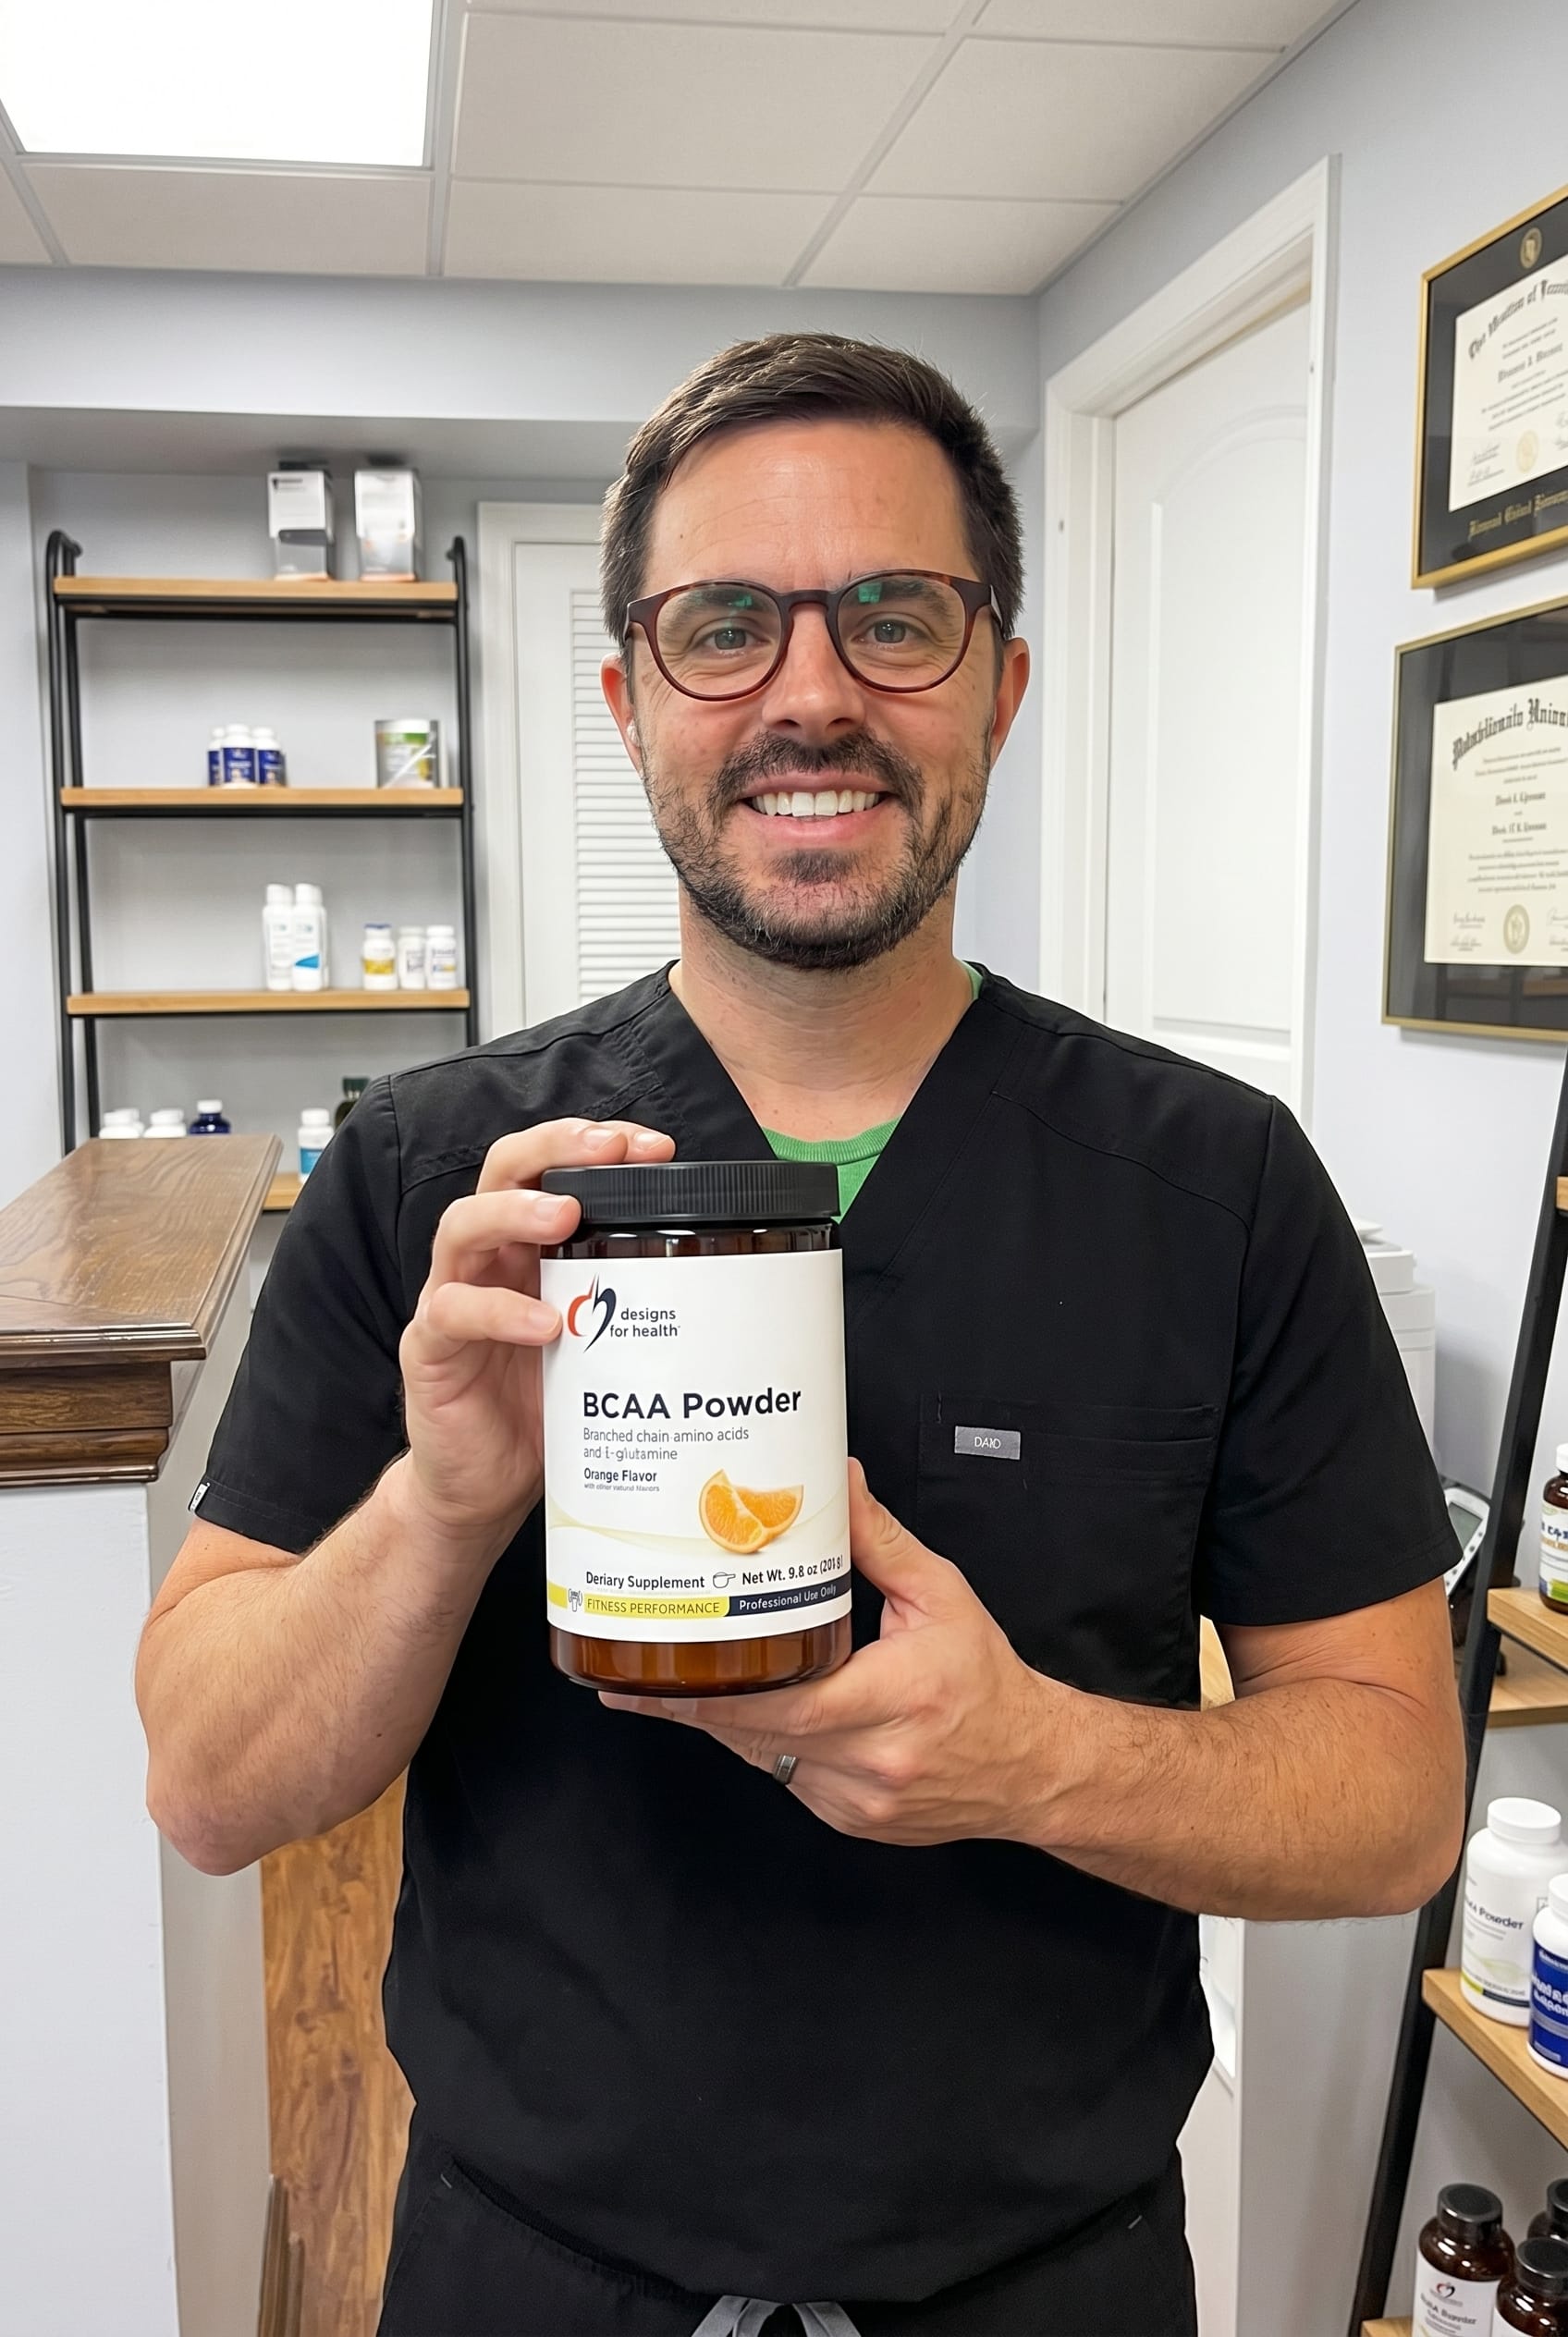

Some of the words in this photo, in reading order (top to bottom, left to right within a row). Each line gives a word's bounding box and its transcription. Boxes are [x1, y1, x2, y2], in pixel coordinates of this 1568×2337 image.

[620, 1308, 676, 1323] designs
[610, 1325, 629, 1338] for
[632, 1324, 679, 1338] health
[583, 1392, 671, 1420] BCAA
[683, 1388, 802, 1419] Powder
[583, 1427, 633, 1443] Branched
[636, 1429, 669, 1443] chain
[673, 1429, 714, 1443] amino
[717, 1427, 750, 1442] acids
[583, 1446, 602, 1459] and
[583, 1467, 619, 1484] Orange
[622, 1470, 658, 1483] Flavor
[586, 1571, 625, 1589] Deriary
[628, 1575, 705, 1591] Supplement
[742, 1572, 764, 1586] Net
[766, 1569, 787, 1584] Wt.
[789, 1565, 805, 1580] 9.8
[807, 1565, 818, 1576] oz
[587, 1598, 628, 1613] FITNESS
[630, 1602, 720, 1615] PERFORMANCE
[739, 1592, 802, 1610] Professional
